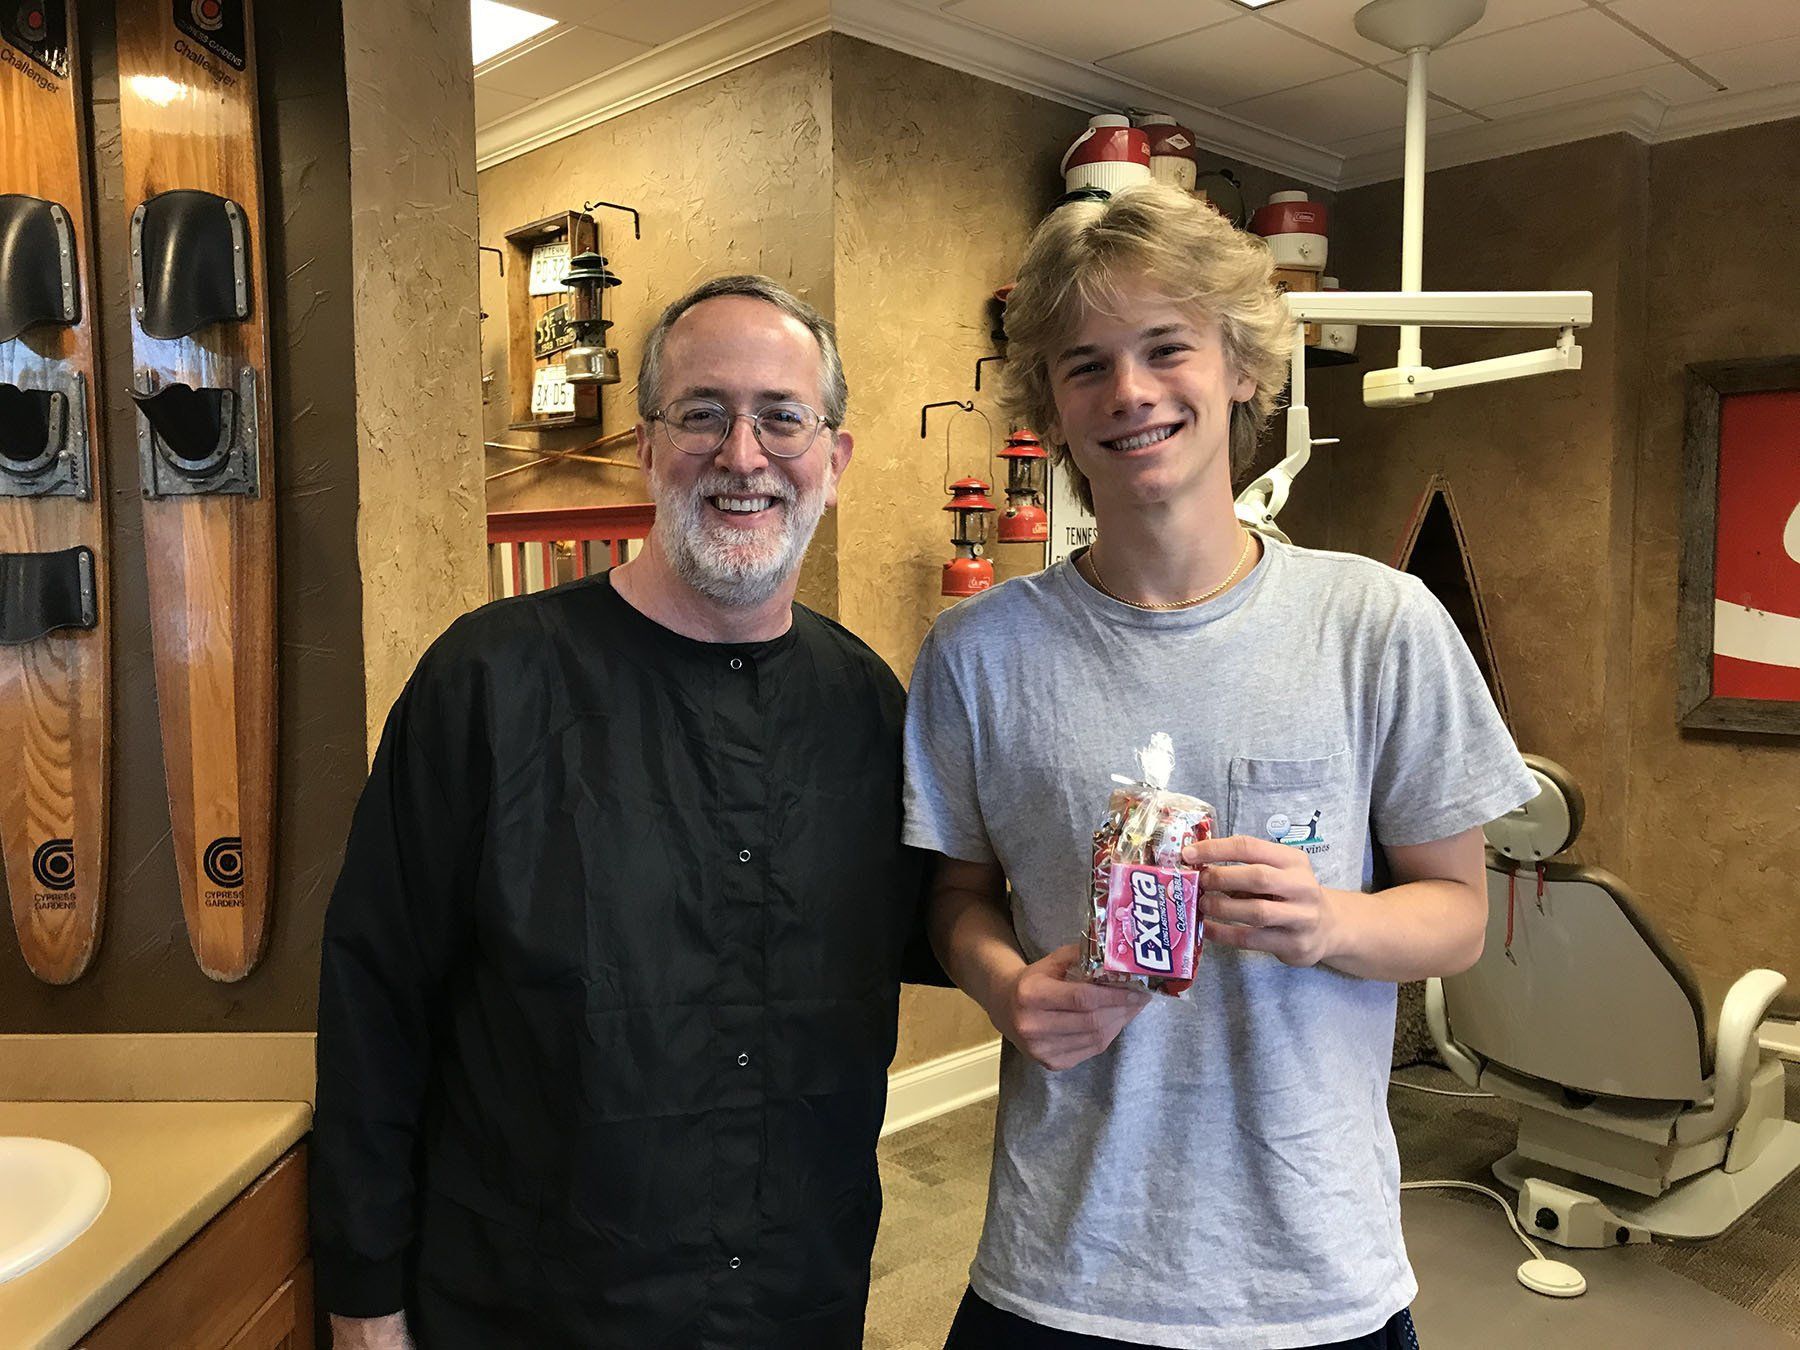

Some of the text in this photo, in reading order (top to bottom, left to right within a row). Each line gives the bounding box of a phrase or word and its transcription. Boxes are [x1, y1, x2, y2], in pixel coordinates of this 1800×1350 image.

[0, 48, 60, 94] Challenger
[173, 39, 238, 88] Challenger
[1305, 844, 1330, 854] vines
[34, 892, 77, 902] CYPRESS
[204, 889, 245, 899] CYPRESS
[204, 899, 245, 908] GARDENS
[1131, 870, 1173, 974] Extra
[1159, 907, 1170, 931] LASTING
[1160, 930, 1171, 947] LONG
